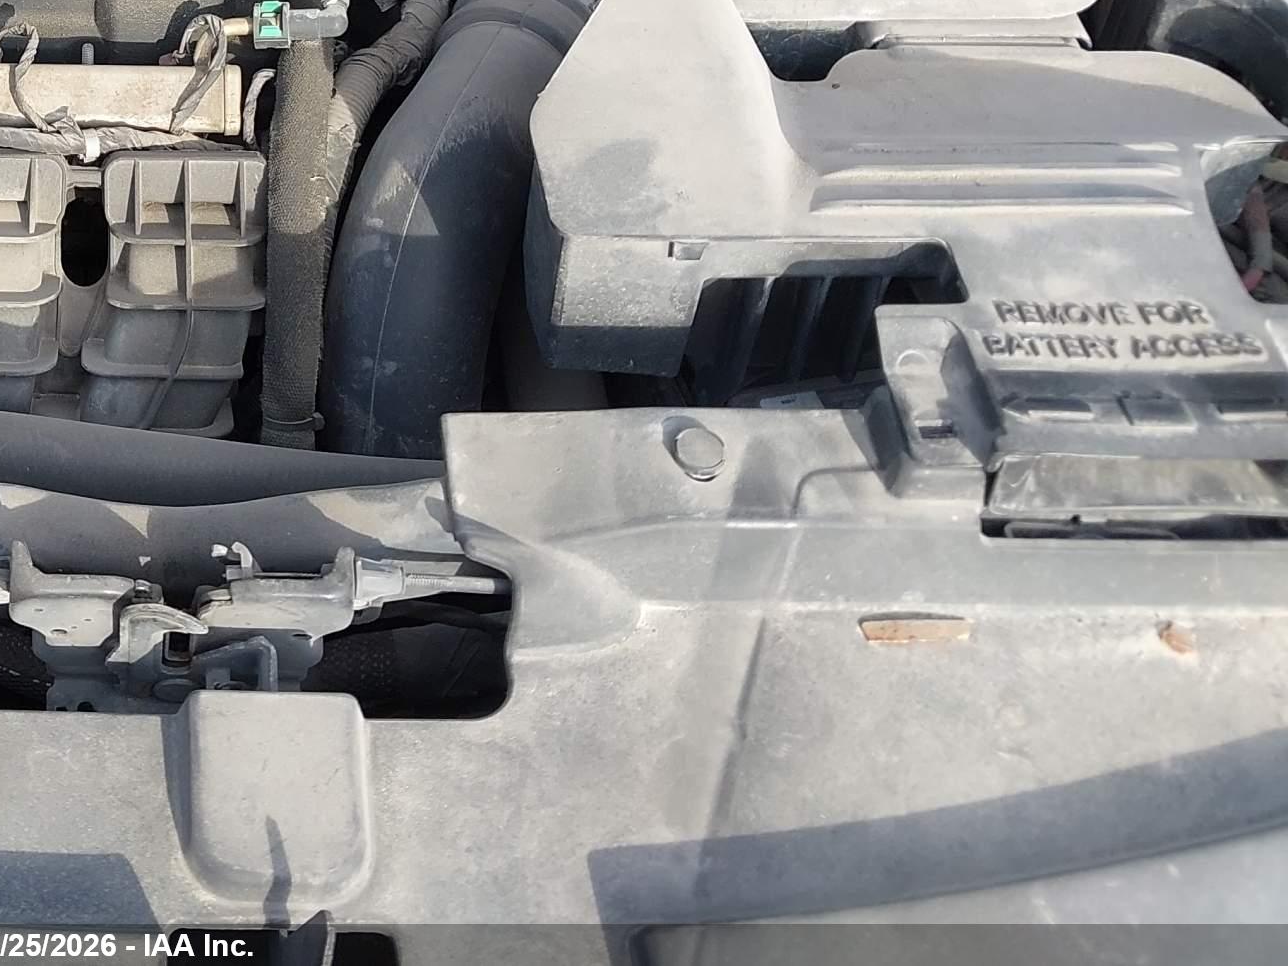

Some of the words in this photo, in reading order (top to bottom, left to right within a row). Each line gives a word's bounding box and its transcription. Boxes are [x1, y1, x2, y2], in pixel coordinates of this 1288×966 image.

[992, 299, 1134, 325] REMOVE
[1136, 299, 1210, 325] FOR
[980, 332, 1120, 359] BATTERY
[1130, 333, 1265, 359] ACCESS
